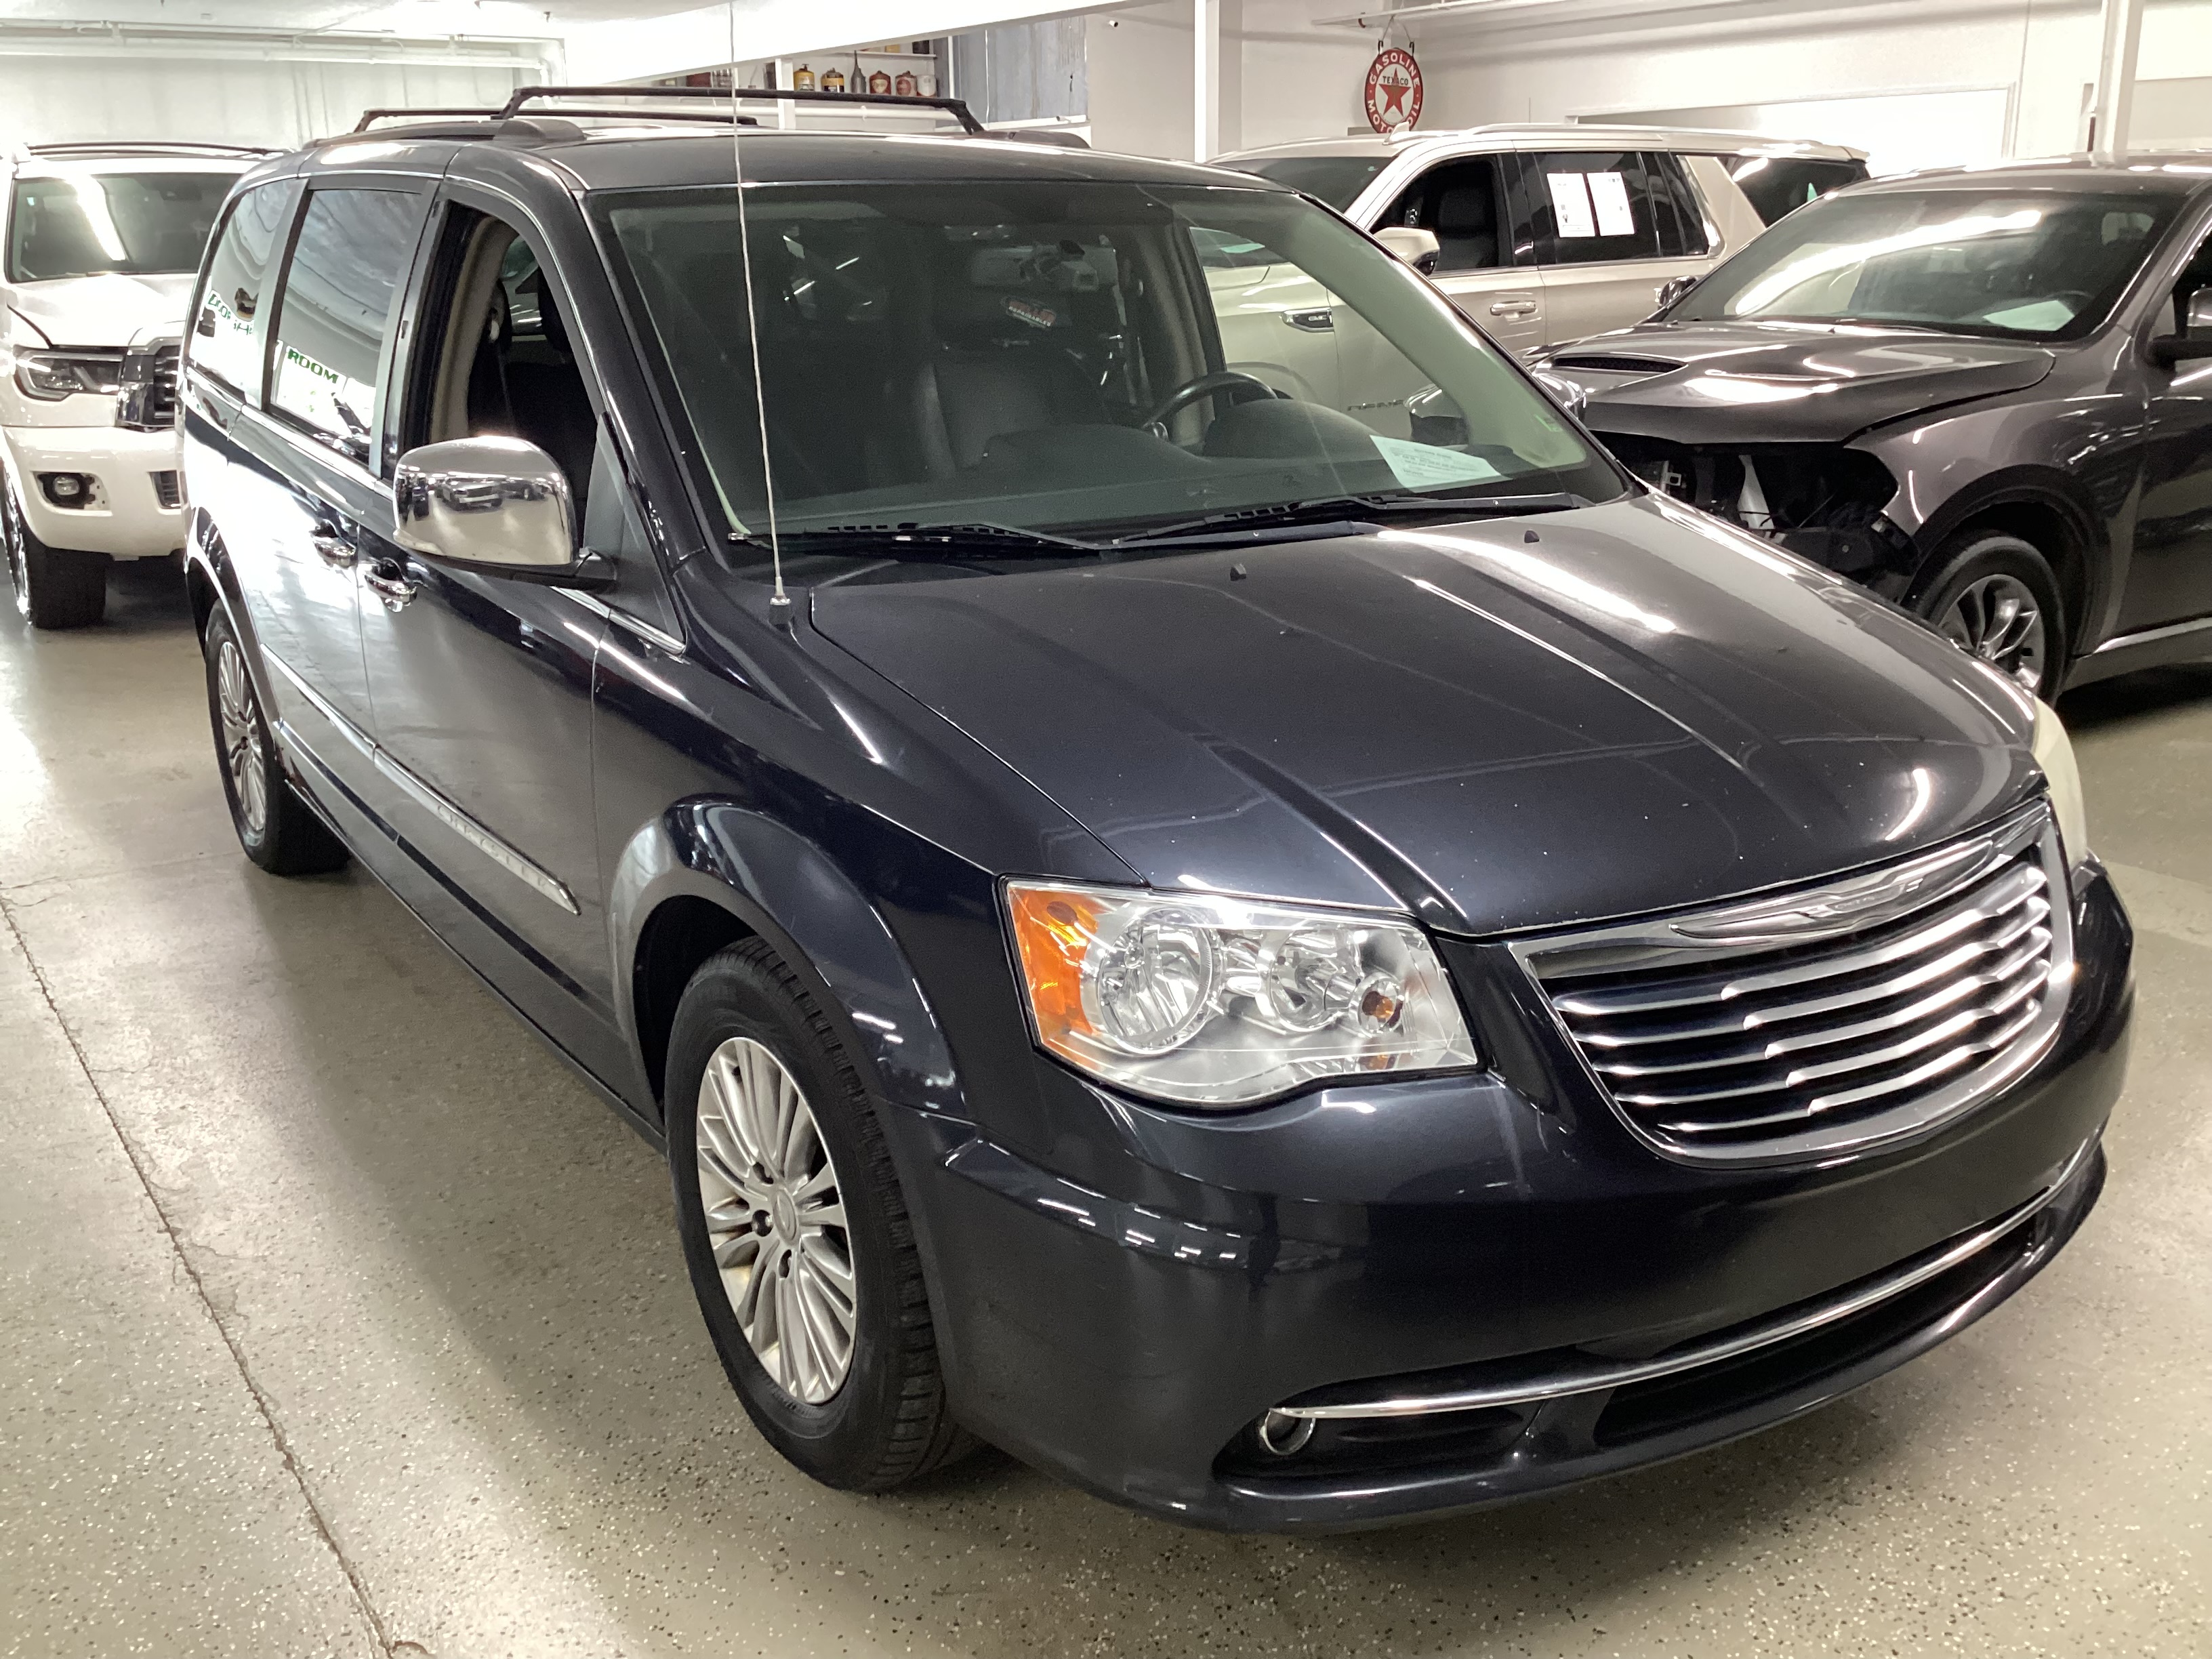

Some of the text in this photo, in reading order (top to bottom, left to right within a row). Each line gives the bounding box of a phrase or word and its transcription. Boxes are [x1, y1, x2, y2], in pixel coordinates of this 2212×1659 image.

[1370, 52, 1420, 87] GASOLINE
[1368, 100, 1393, 134] MOTO
[287, 348, 339, 384] ROOM
